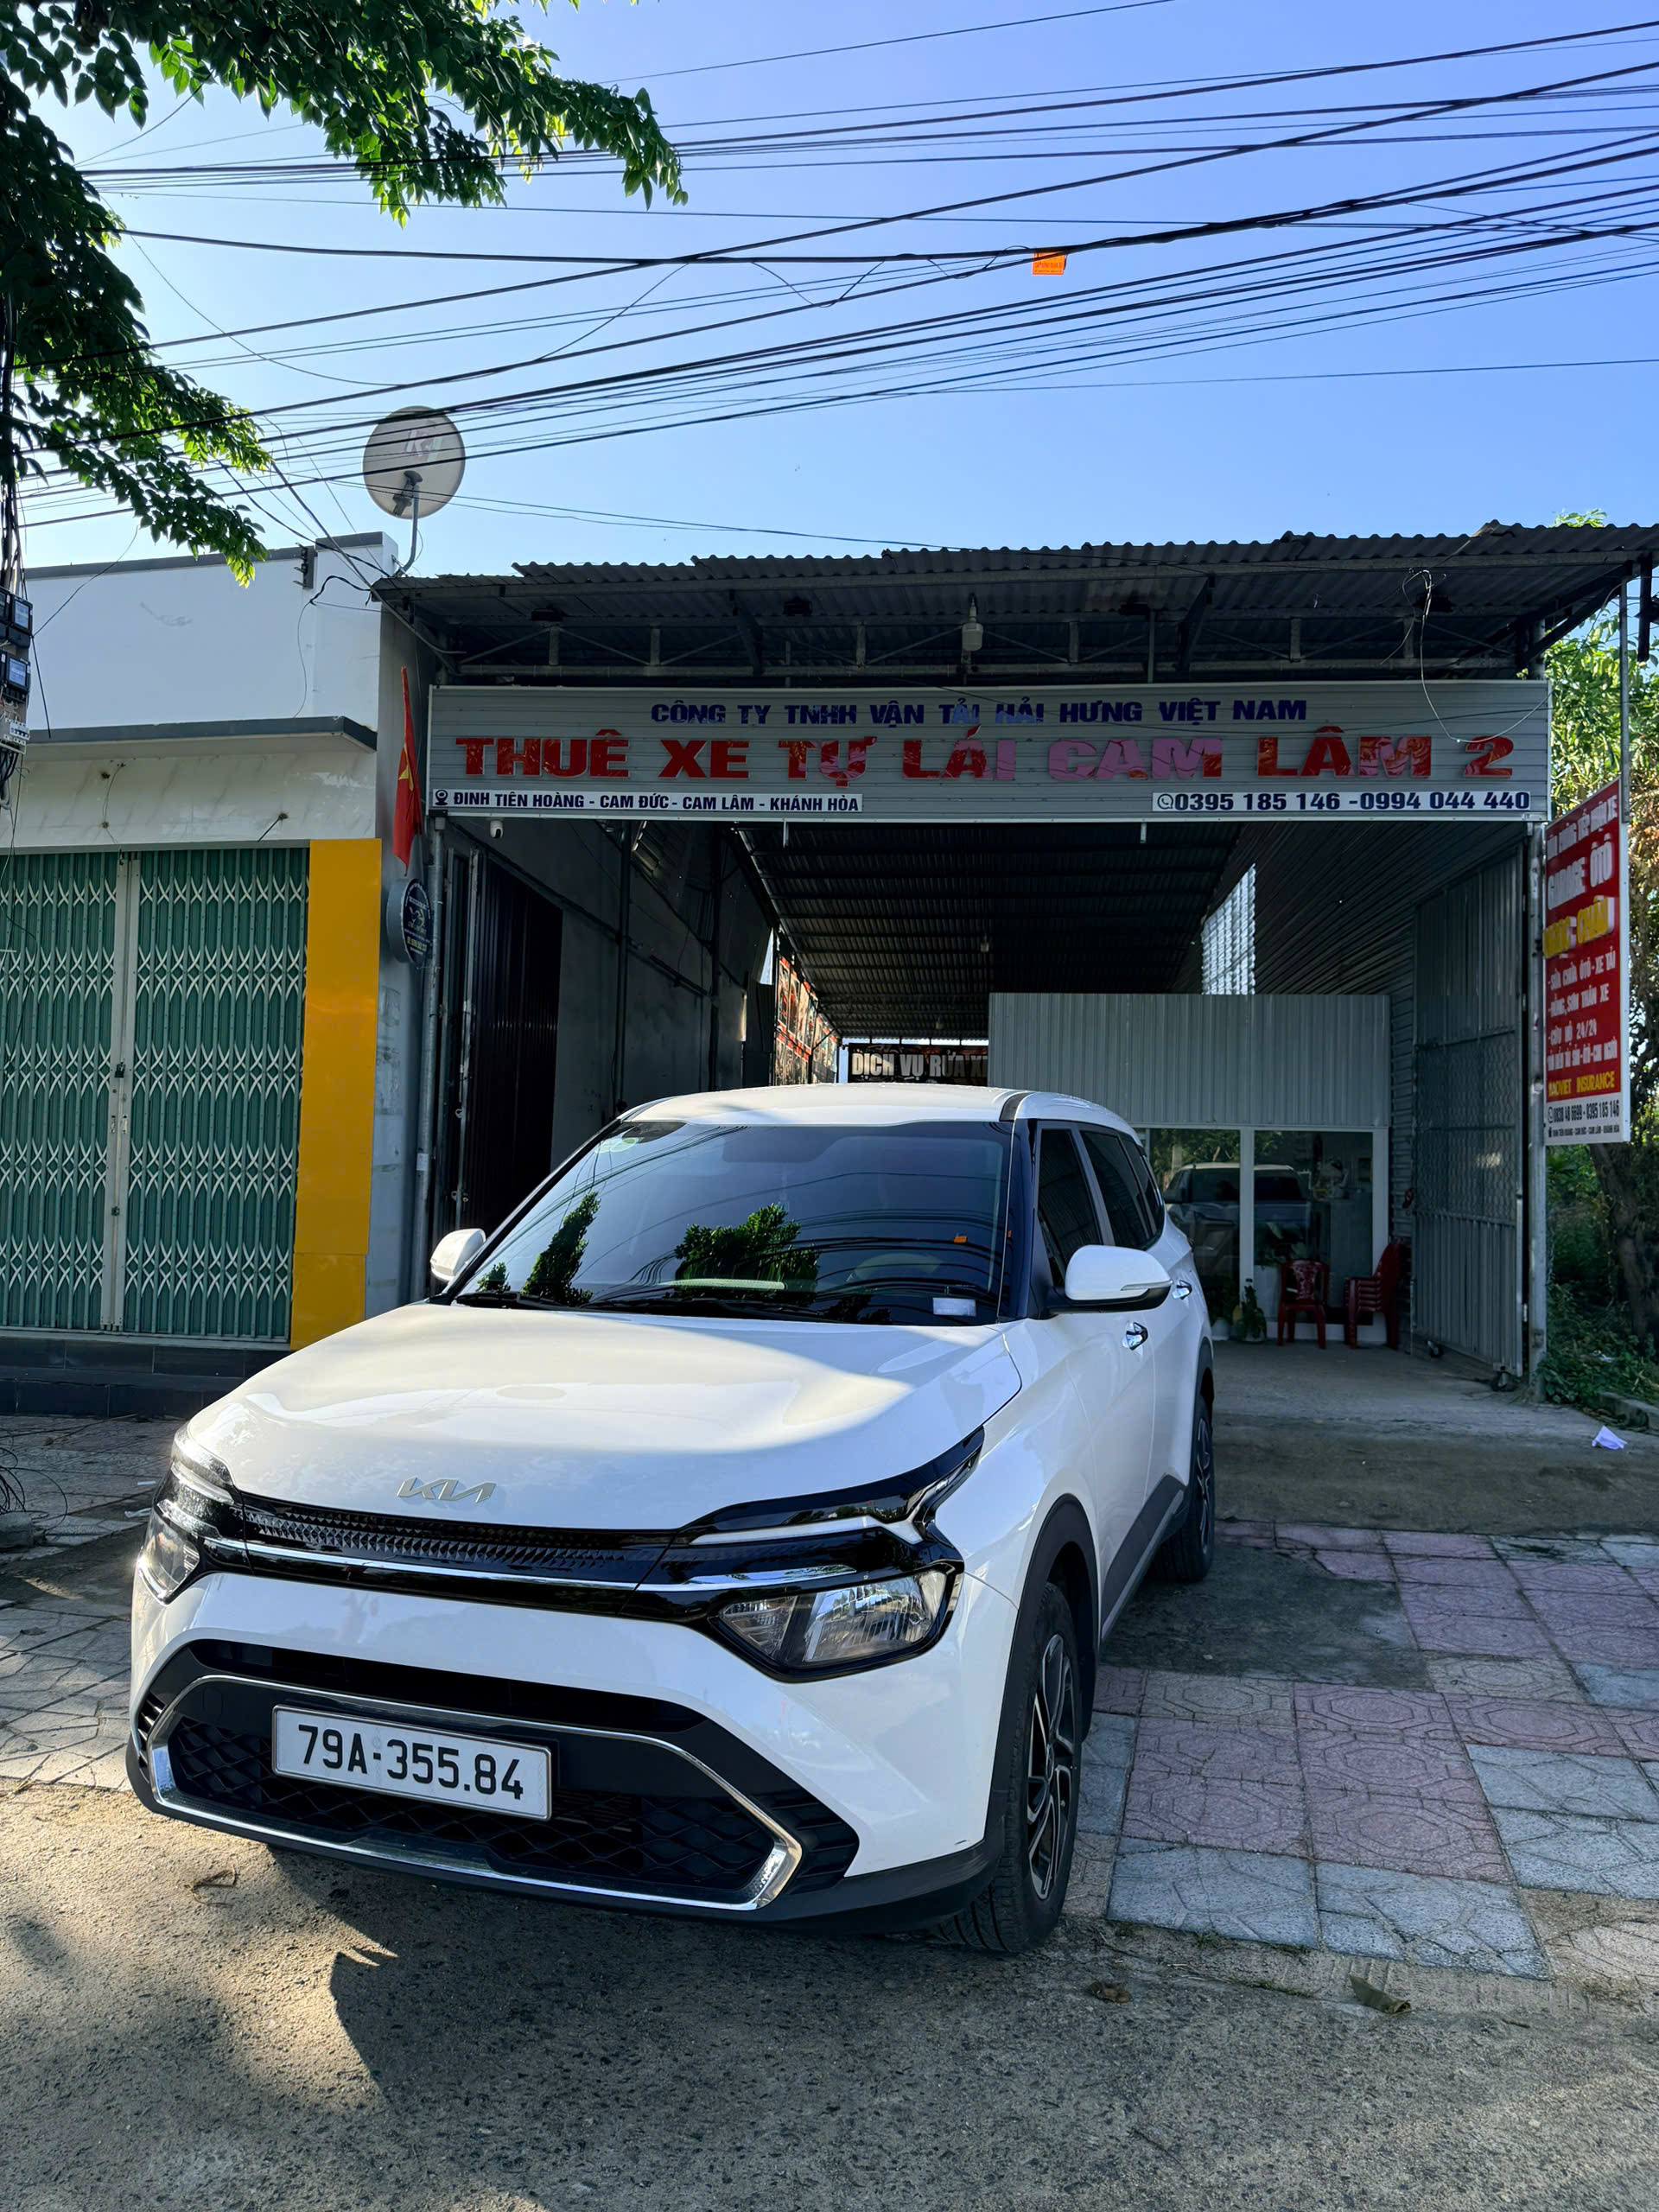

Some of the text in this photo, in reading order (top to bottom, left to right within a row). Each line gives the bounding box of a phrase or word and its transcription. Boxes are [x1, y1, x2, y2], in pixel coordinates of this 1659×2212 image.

[652, 696, 1306, 728] CÔNG TY TNHH VẬN TẢI HẢI HƯNG VIỆT NAM
[455, 724, 1514, 788] THUÊ XE TỰ LÁI CAM LÂM 2
[494, 791, 528, 807] TIÊN
[533, 792, 584, 808] HOÀNG
[600, 795, 634, 808] CAM
[639, 793, 669, 809] ĐỨC
[683, 797, 716, 810] CAM
[721, 795, 754, 810] LÂM
[770, 797, 823, 811] KHÁNH
[827, 796, 859, 811] HÒA
[1175, 793, 1234, 810] 0395
[1243, 793, 1287, 810] 185
[1296, 792, 1340, 810] 146
[1430, 791, 1476, 810] 044
[1484, 791, 1530, 810] 440
[851, 1052, 894, 1079] DỊCH
[899, 1054, 924, 1080] VỤ
[1576, 1071, 1615, 1093] INSURANCE
[397, 1477, 496, 1503] KIA
[298, 1724, 524, 1800] 79A-355.84
